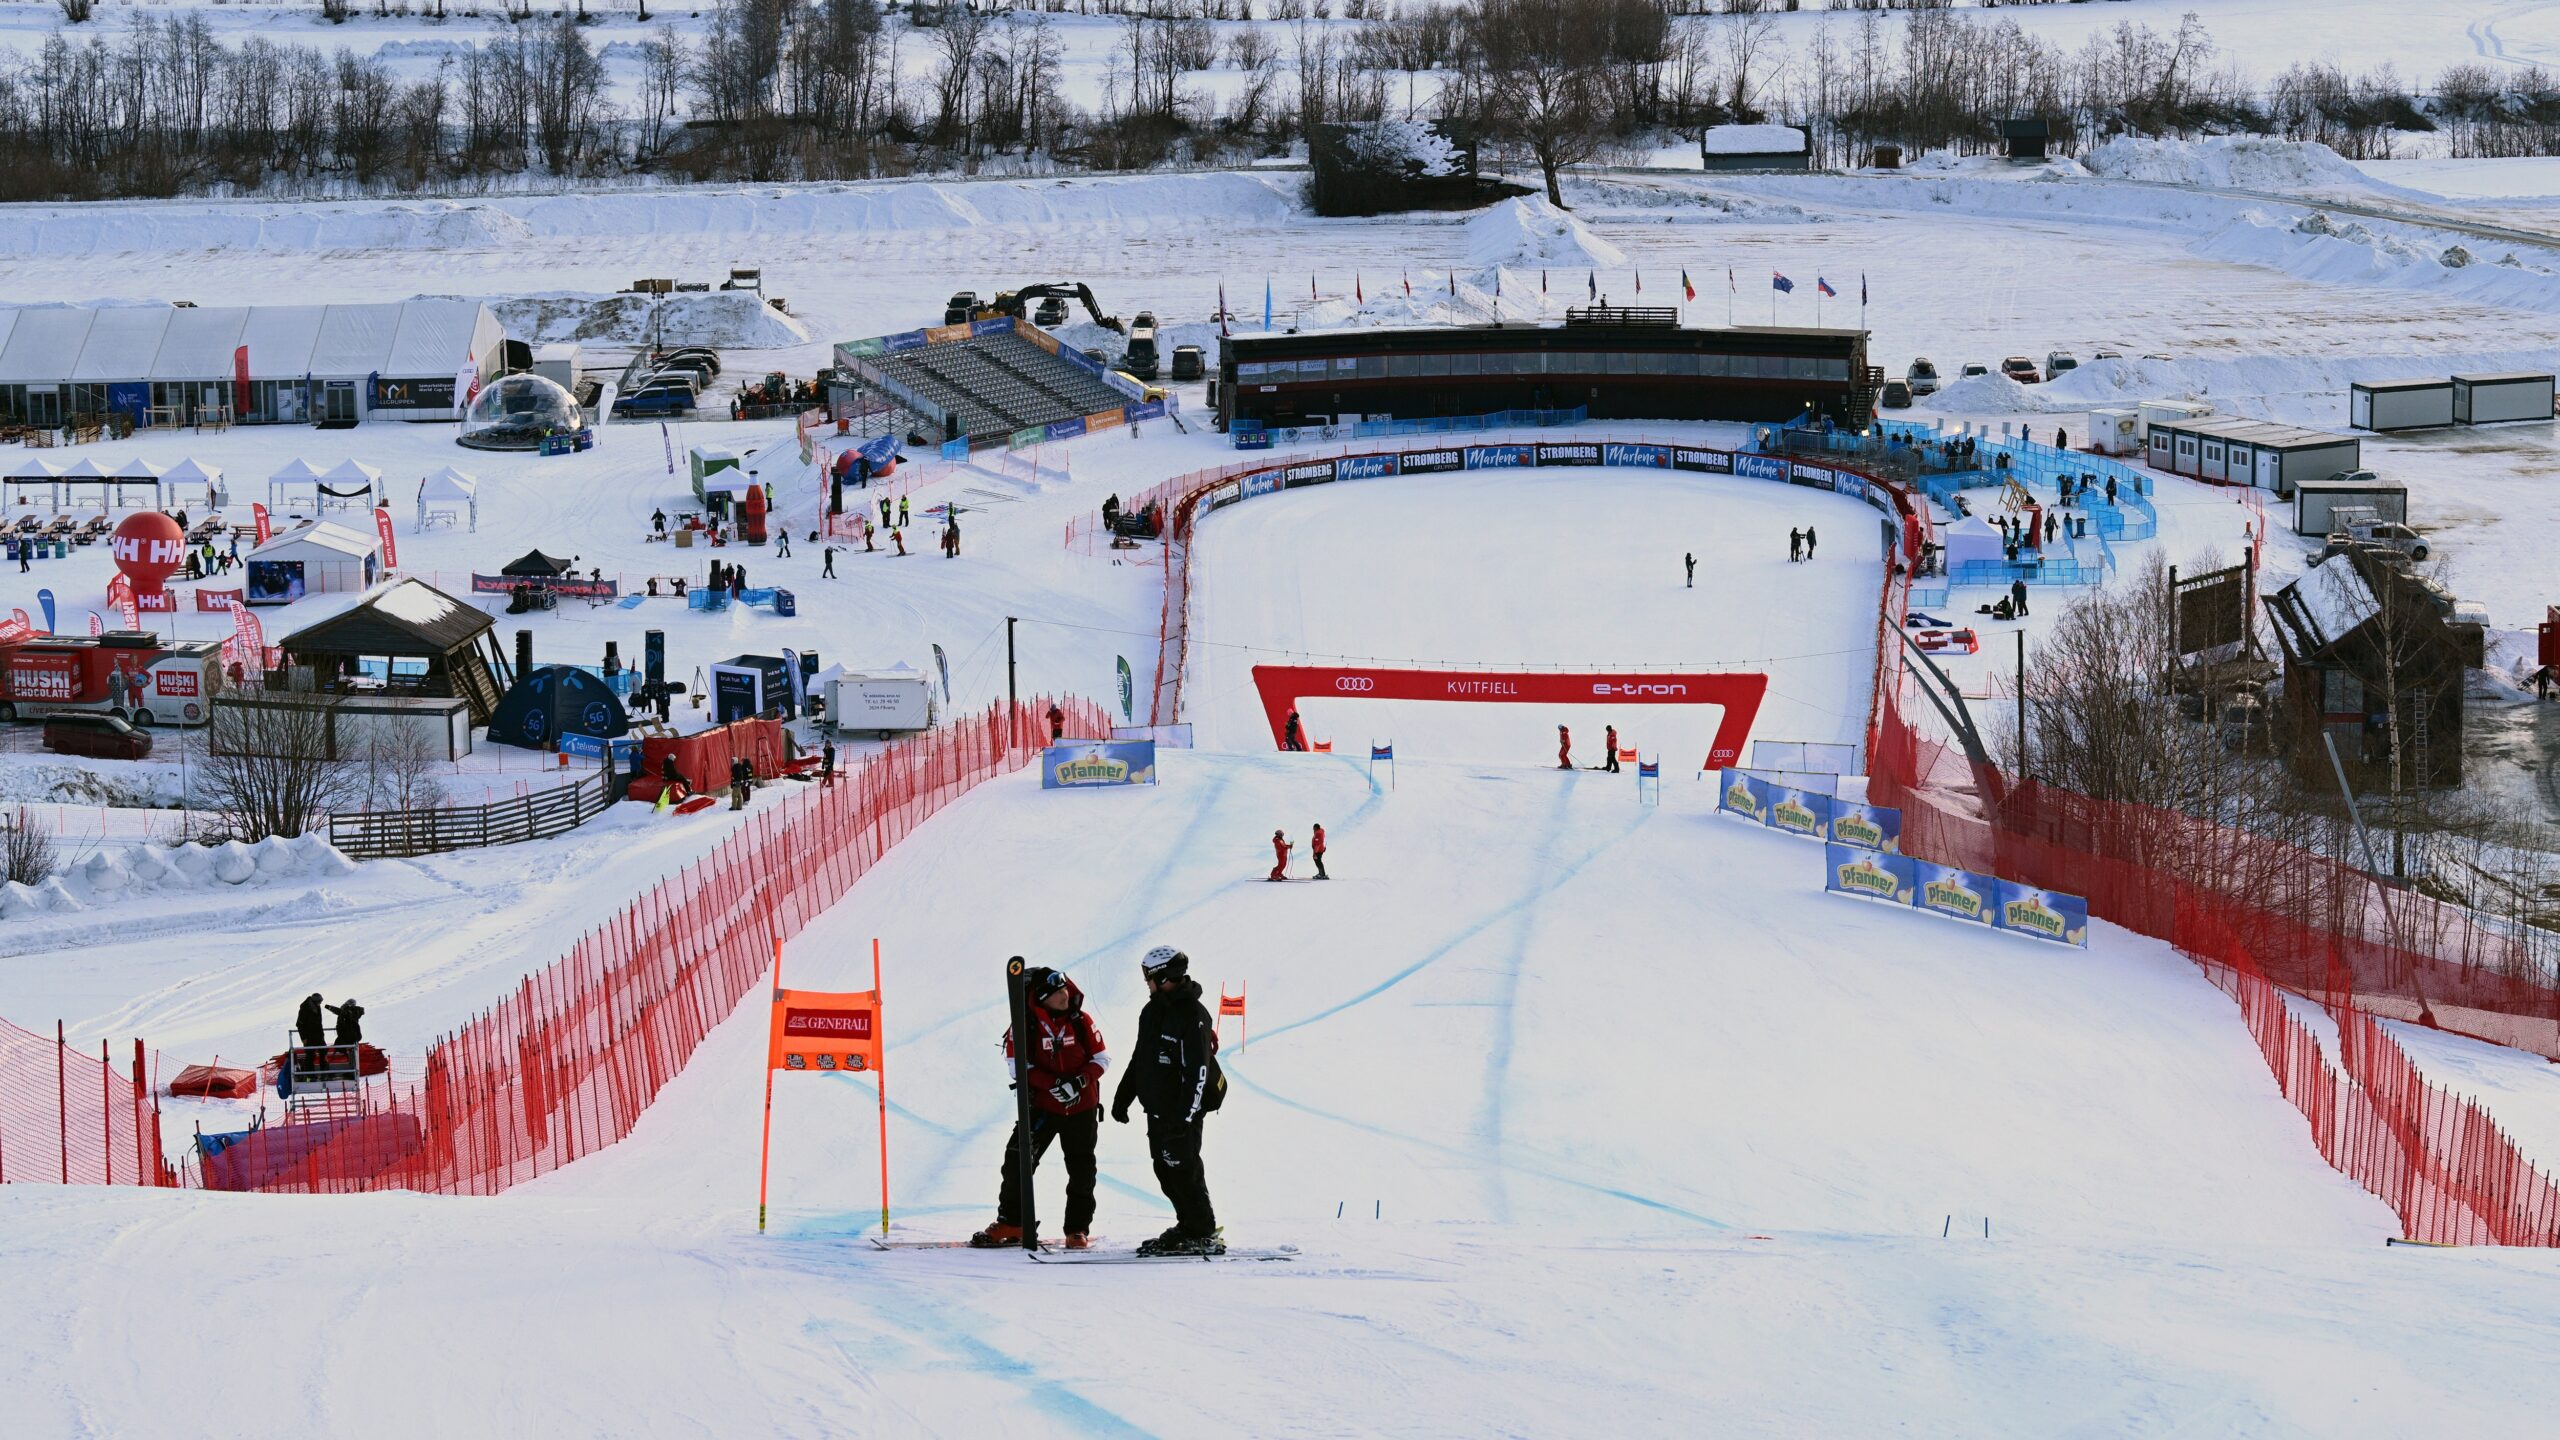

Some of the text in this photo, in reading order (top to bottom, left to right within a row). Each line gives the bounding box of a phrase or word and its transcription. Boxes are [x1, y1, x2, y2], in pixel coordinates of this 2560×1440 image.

[1404, 452, 1458, 467] STRØMBERG
[1470, 448, 1517, 468] Marlene
[1540, 446, 1597, 459] STRØMBERG
[1608, 446, 1655, 466] Marlene
[1676, 450, 1729, 465] STRØMBERG
[1287, 464, 1332, 481] STRØMBERG
[1340, 460, 1383, 480] Marlene
[1738, 456, 1777, 477] Marlene
[1244, 476, 1274, 495] Marlene
[150, 540, 184, 563] HH
[138, 595, 164, 608] HH
[207, 595, 232, 608] HH
[13, 670, 70, 688] HUSKI
[160, 674, 194, 686] HUSKI
[15, 688, 70, 698] CHOCOLATE
[1447, 682, 1517, 694] KVITFJELL
[1593, 683, 1686, 695] e-tron
[528, 720, 541, 730] 5G
[589, 712, 604, 723] 5G
[576, 742, 600, 752] telenor
[1060, 763, 1123, 780] pfanner
[1728, 788, 1753, 812] pfanner
[1776, 806, 1812, 827] pfanner
[1838, 822, 1878, 843] pfanner
[1843, 869, 1893, 894] pfanner
[1928, 886, 1977, 913] pfanner
[2010, 906, 2060, 933] pfanner
[808, 1017, 868, 1030] GENERALI
[1184, 1065, 1206, 1122] HEAD
